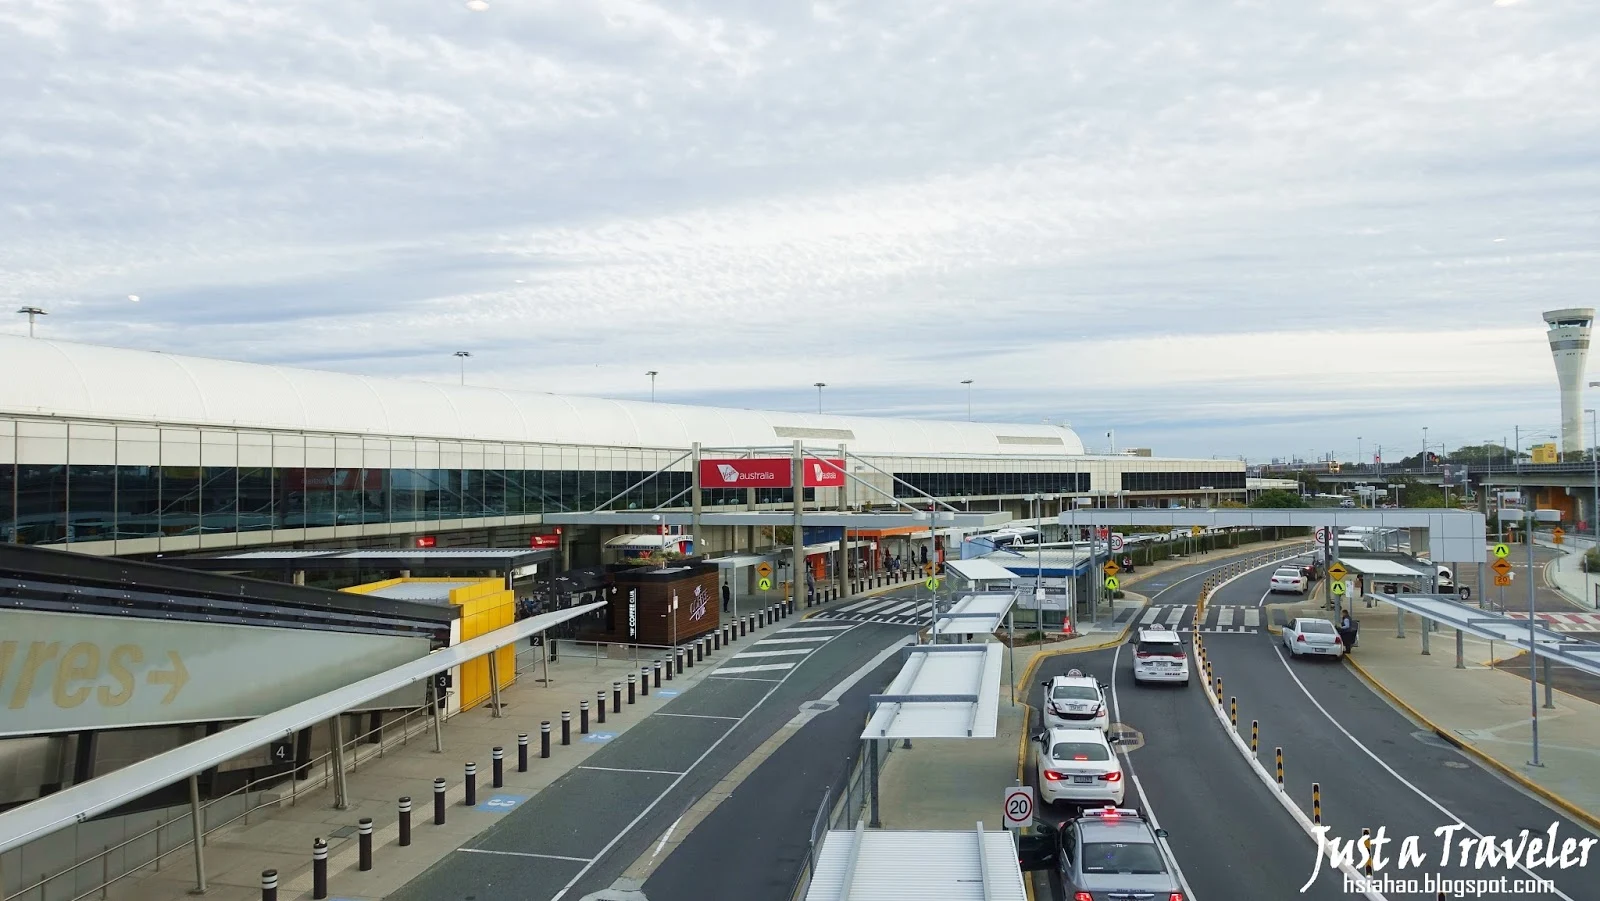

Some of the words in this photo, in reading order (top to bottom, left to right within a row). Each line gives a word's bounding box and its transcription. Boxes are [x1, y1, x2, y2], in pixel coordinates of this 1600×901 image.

[740, 471, 774, 480] australia
[533, 637, 539, 646] 2
[0, 640, 144, 710] res
[439, 676, 447, 687] 3
[276, 745, 285, 759] 4
[1010, 800, 1028, 814] 20
